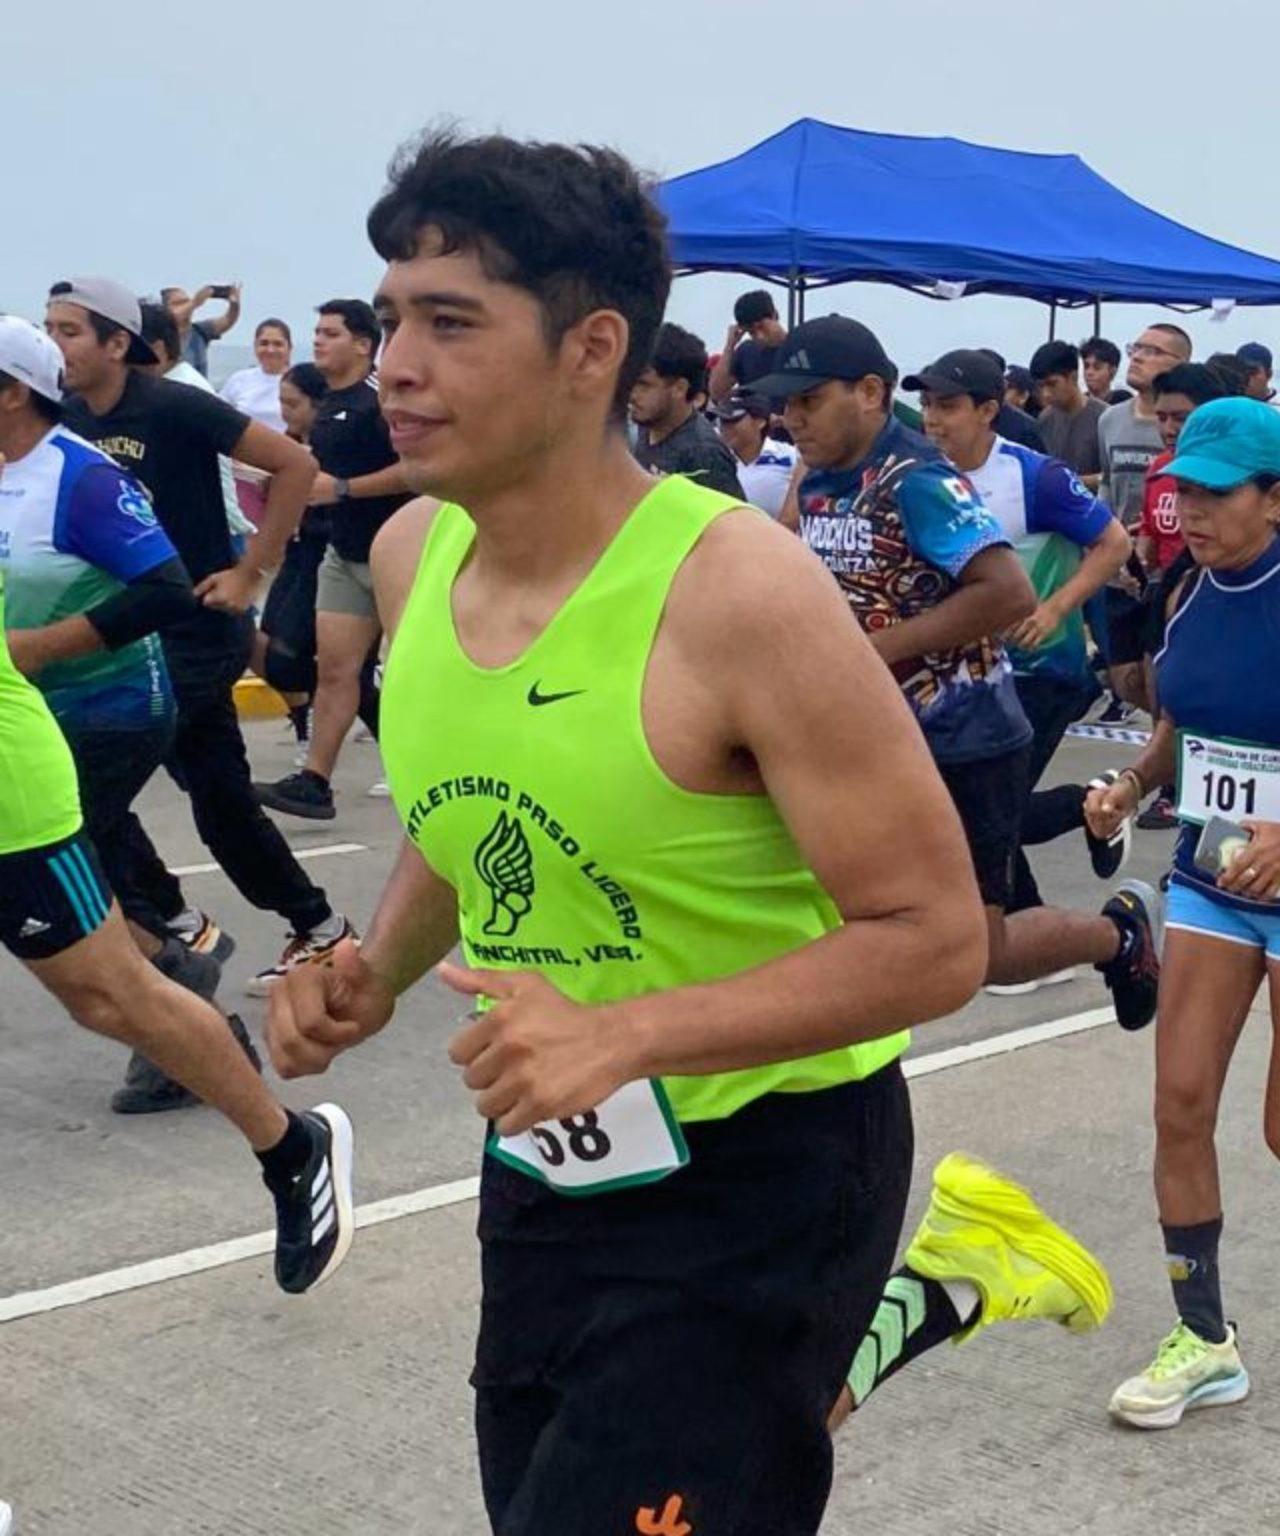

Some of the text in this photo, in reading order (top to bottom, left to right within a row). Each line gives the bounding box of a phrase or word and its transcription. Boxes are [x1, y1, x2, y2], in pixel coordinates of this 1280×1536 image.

[1203, 771, 1256, 814] 101
[406, 776, 642, 939] ATLETISMO PASO LIGERO
[583, 944, 642, 963] VER.
